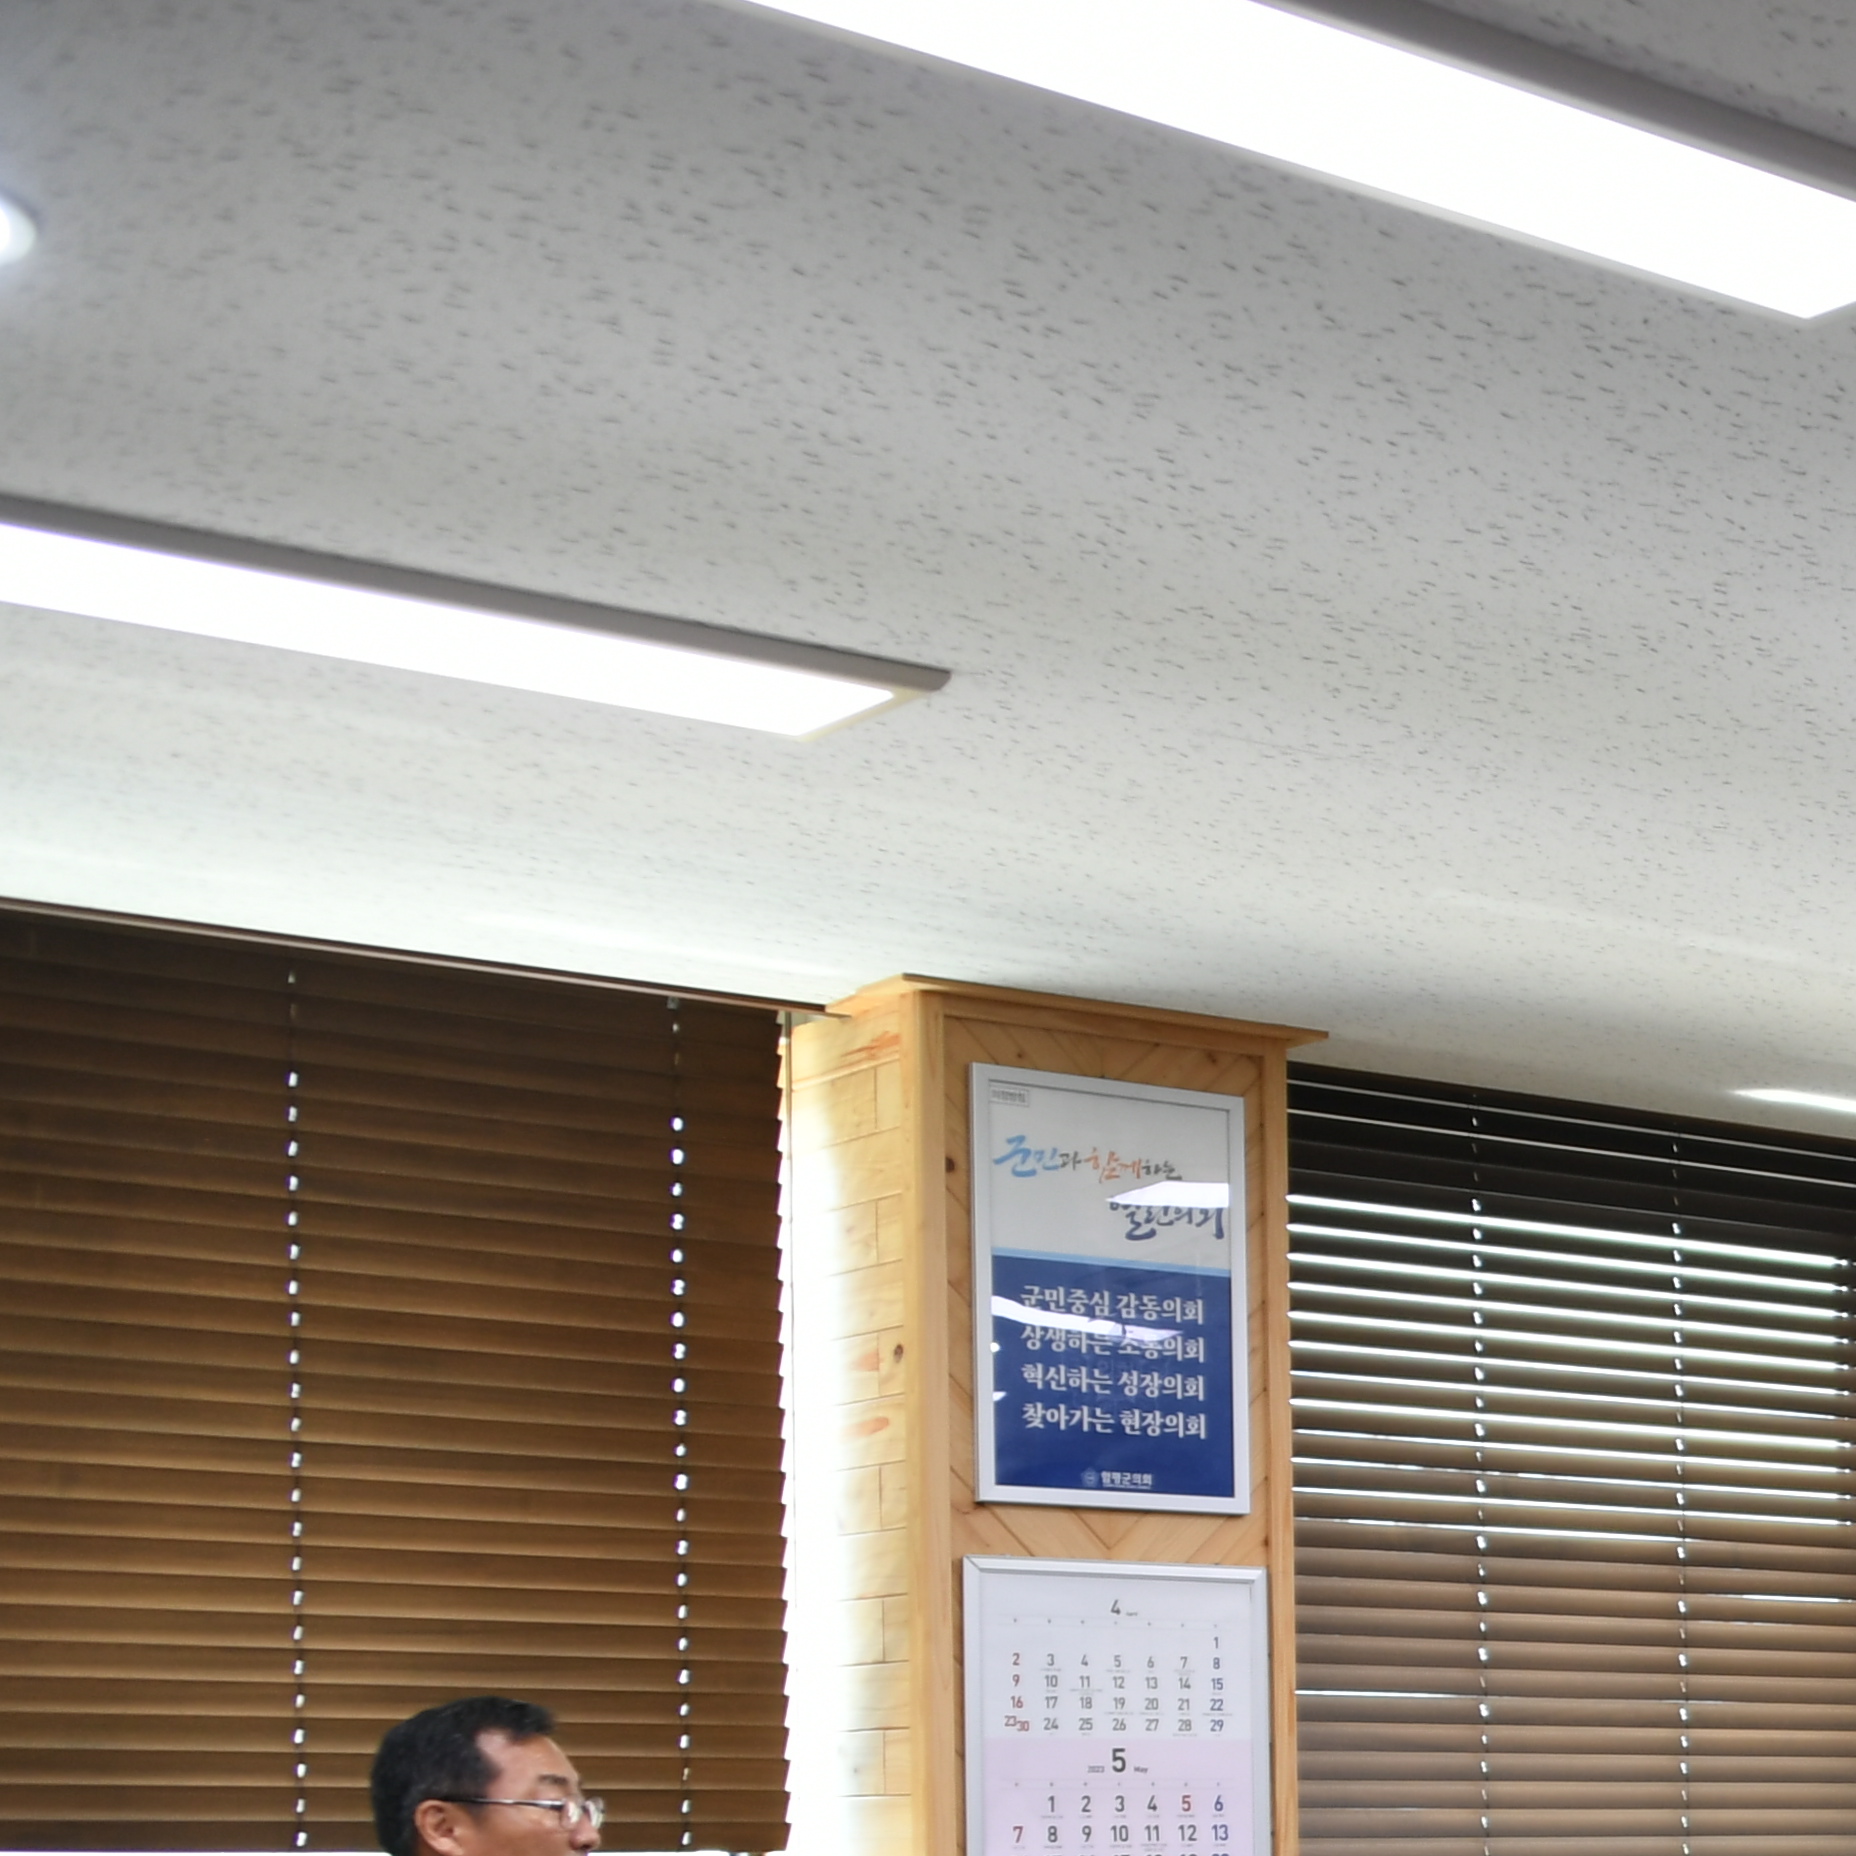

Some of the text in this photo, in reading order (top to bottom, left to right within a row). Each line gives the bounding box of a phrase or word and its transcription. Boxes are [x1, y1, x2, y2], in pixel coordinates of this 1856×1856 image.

[1020, 1285, 1203, 1325] 군민중심 감동의회
[1020, 1325, 1113, 1355] 상생하는
[1020, 1362, 1205, 1401] 혁신하는 성장의회
[1022, 1402, 1207, 1440] 찾아가는 현장의회
[1110, 1599, 1121, 1616] 4
[1044, 1674, 1059, 1688] 10
[1079, 1675, 1091, 1688] 11
[1112, 1675, 1125, 1690] 12
[1145, 1676, 1159, 1690] 13
[1178, 1677, 1192, 1690] 14
[1211, 1677, 1224, 1691] 15
[1010, 1695, 1224, 1712] 16 17 18 19 20 21 22
[1043, 1717, 1059, 1731] 24
[1078, 1717, 1094, 1731] 25
[1112, 1717, 1127, 1731] 26
[1145, 1718, 1160, 1732] 27
[1178, 1718, 1192, 1732] 28
[1210, 1719, 1224, 1732] 29
[1111, 1747, 1127, 1773] 5
[1048, 1794, 1224, 1813] 1 2 3 4 5 6
[1012, 1824, 1229, 1843] 7 8 9 10 11 12 13
